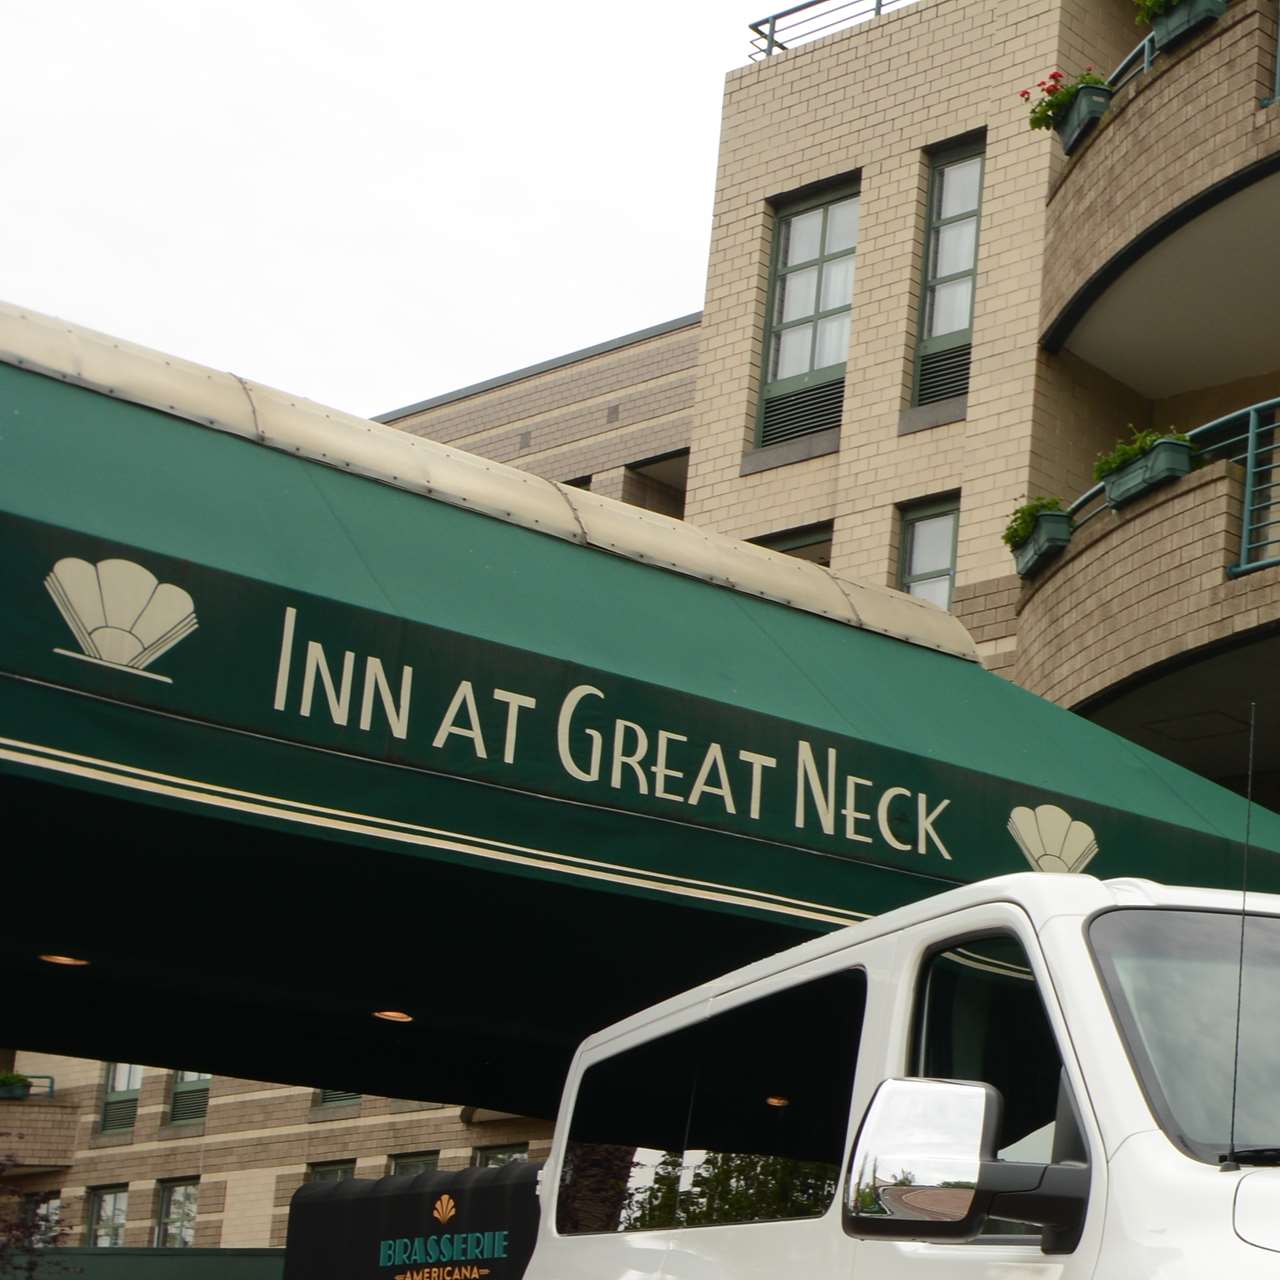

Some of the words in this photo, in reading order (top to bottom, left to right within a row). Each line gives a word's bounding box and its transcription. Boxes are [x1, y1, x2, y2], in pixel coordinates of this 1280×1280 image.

[273, 606, 413, 740] INN
[432, 680, 537, 765] AT
[556, 683, 778, 822] GREAT
[794, 739, 954, 862] NECK
[379, 1231, 509, 1267] BRASSERIE
